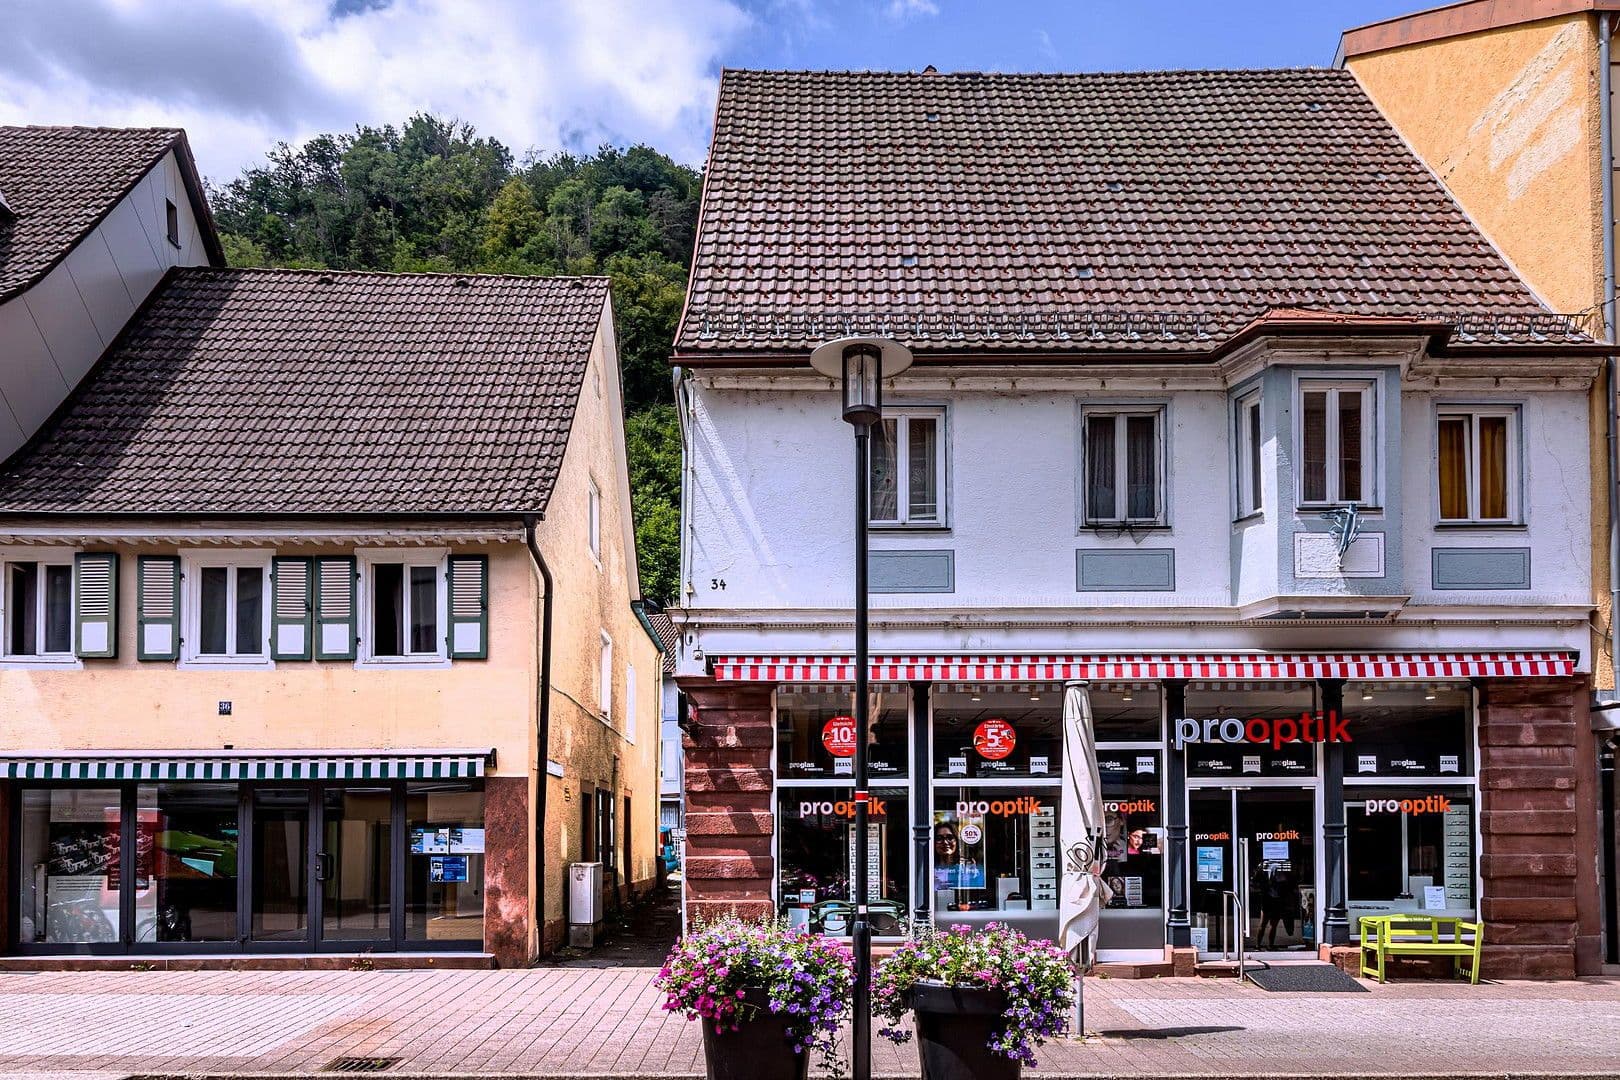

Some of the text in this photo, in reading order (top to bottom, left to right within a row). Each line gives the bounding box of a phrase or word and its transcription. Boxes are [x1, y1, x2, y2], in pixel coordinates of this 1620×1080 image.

[711, 579, 727, 590] 34
[219, 702, 231, 711] 36
[800, 797, 887, 818] proopik
[1102, 800, 1155, 814] rooptik
